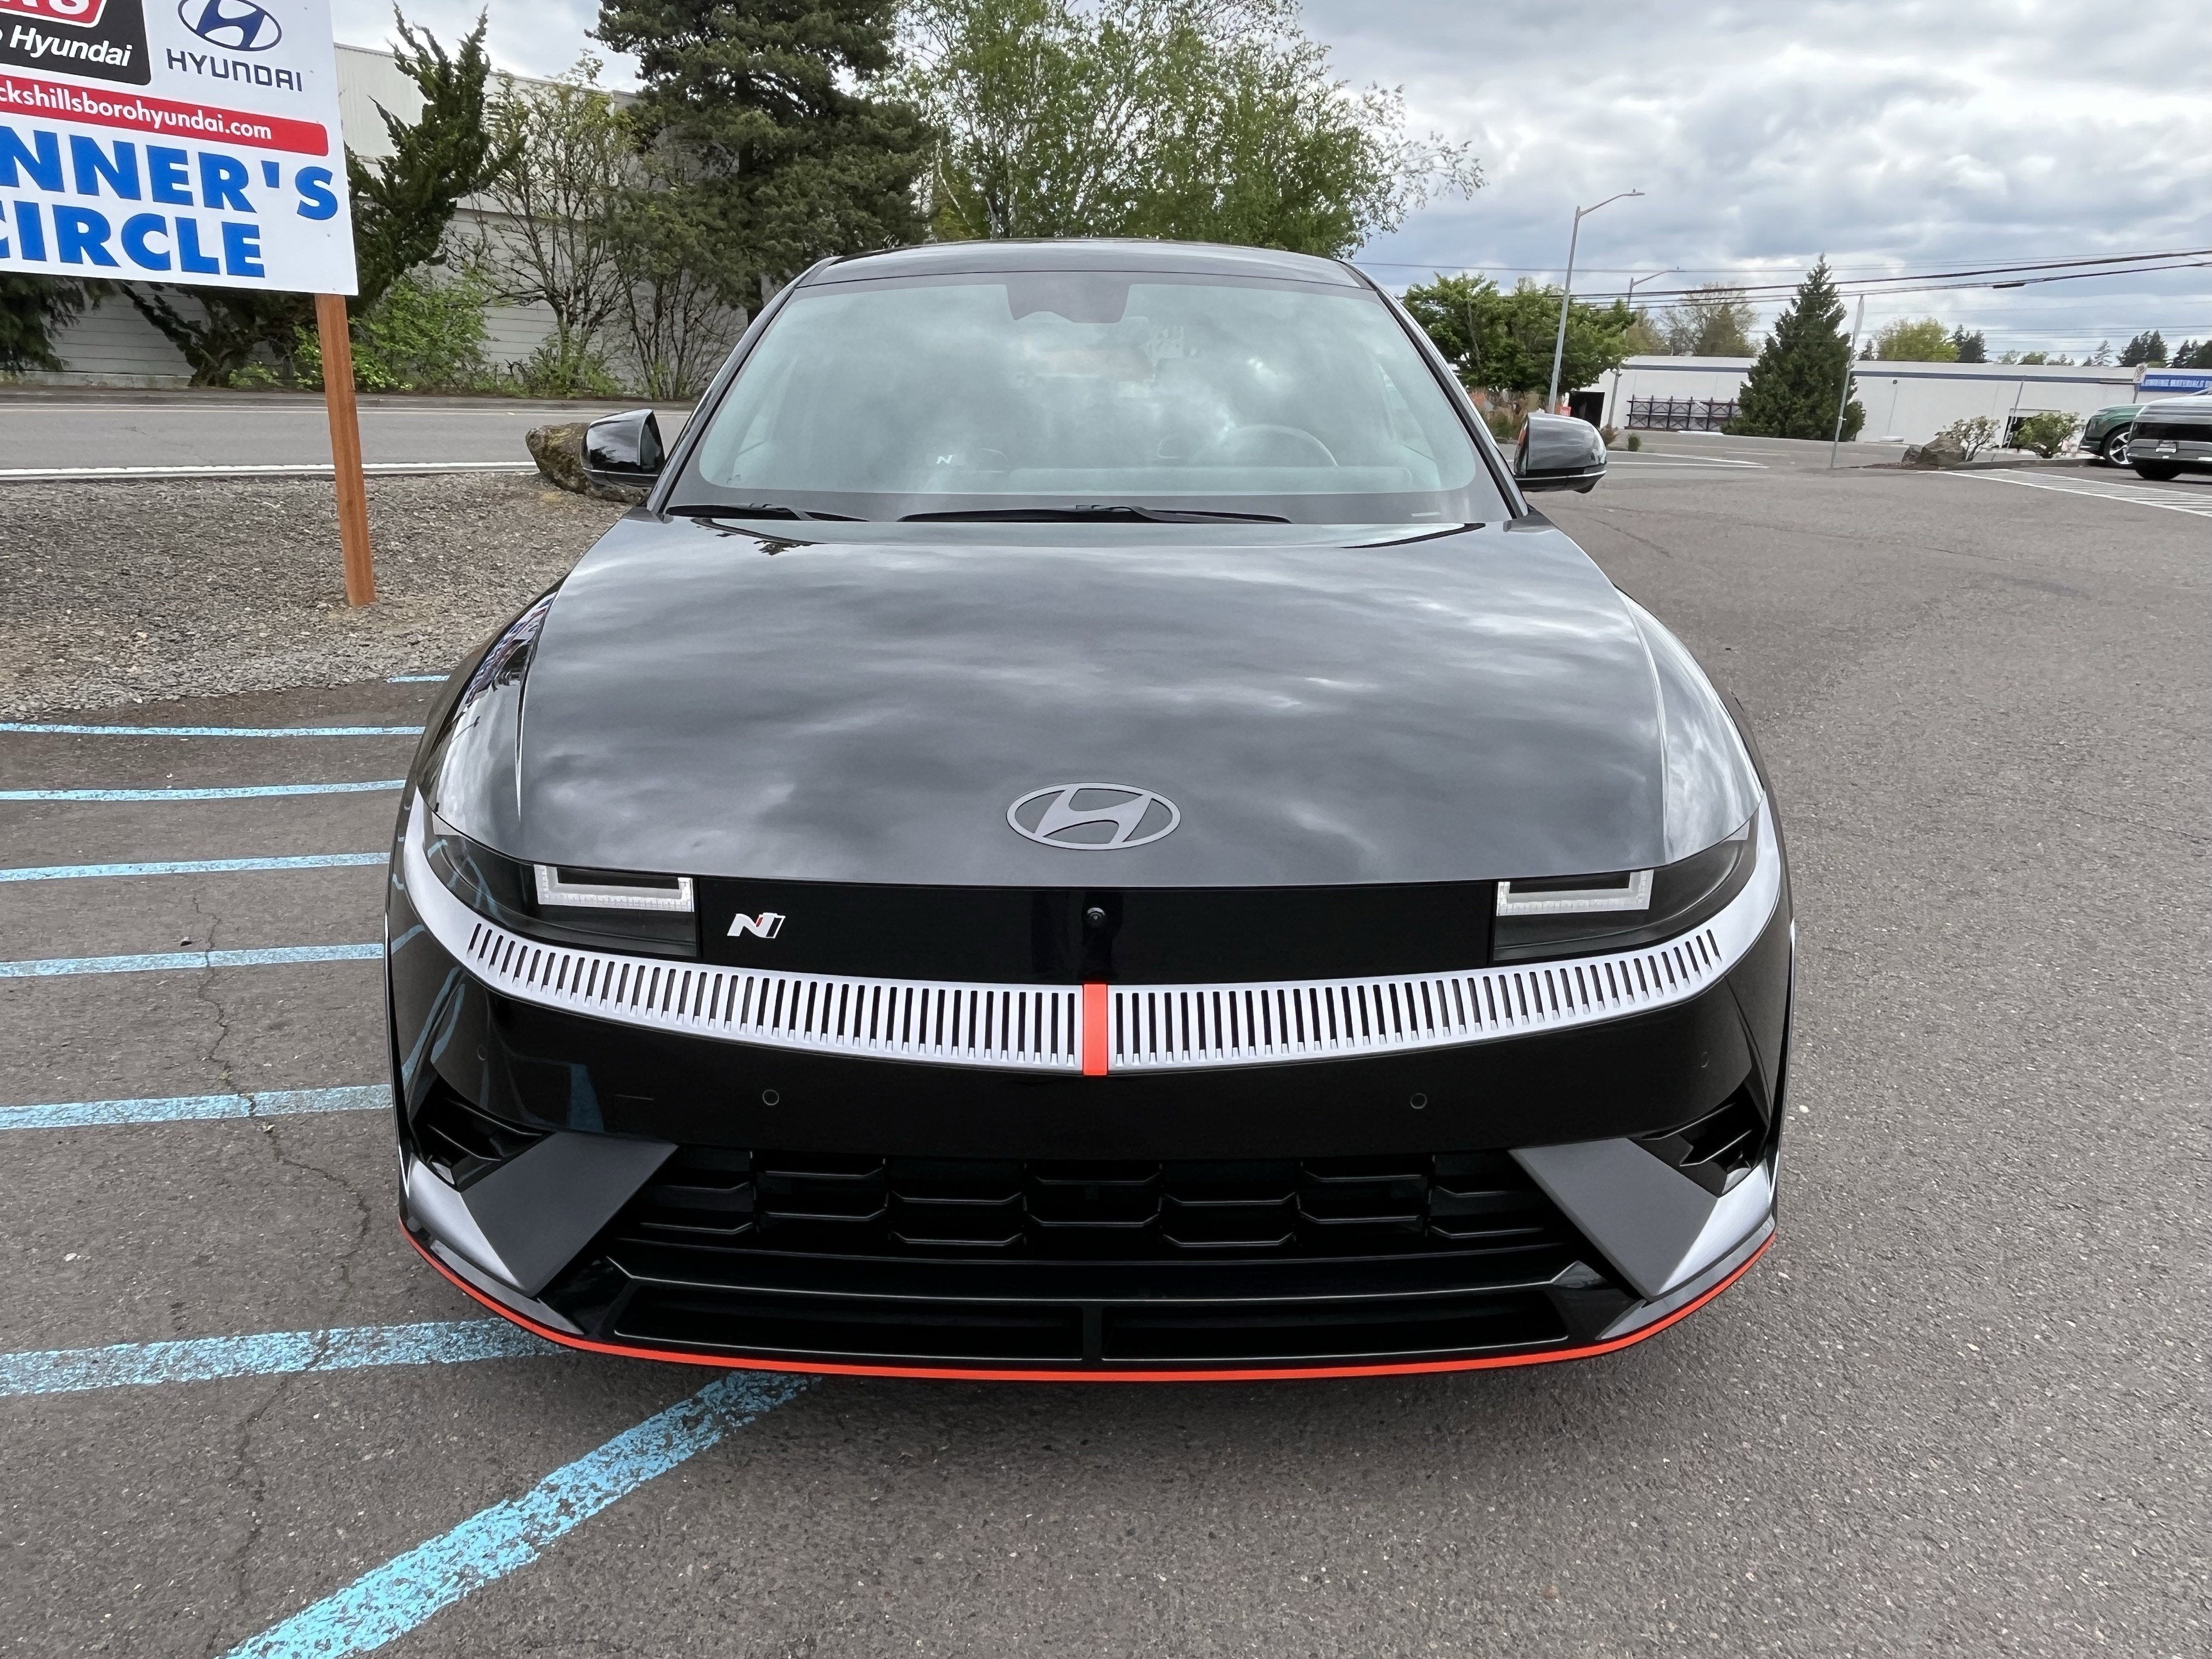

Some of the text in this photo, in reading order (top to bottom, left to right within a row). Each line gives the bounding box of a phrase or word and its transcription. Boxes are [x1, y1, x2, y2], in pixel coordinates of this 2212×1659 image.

[9, 25, 133, 67] Hyundai
[166, 48, 302, 92] HYUNDAI
[0, 126, 338, 221] NNER'S
[0, 200, 265, 278] IRCLE
